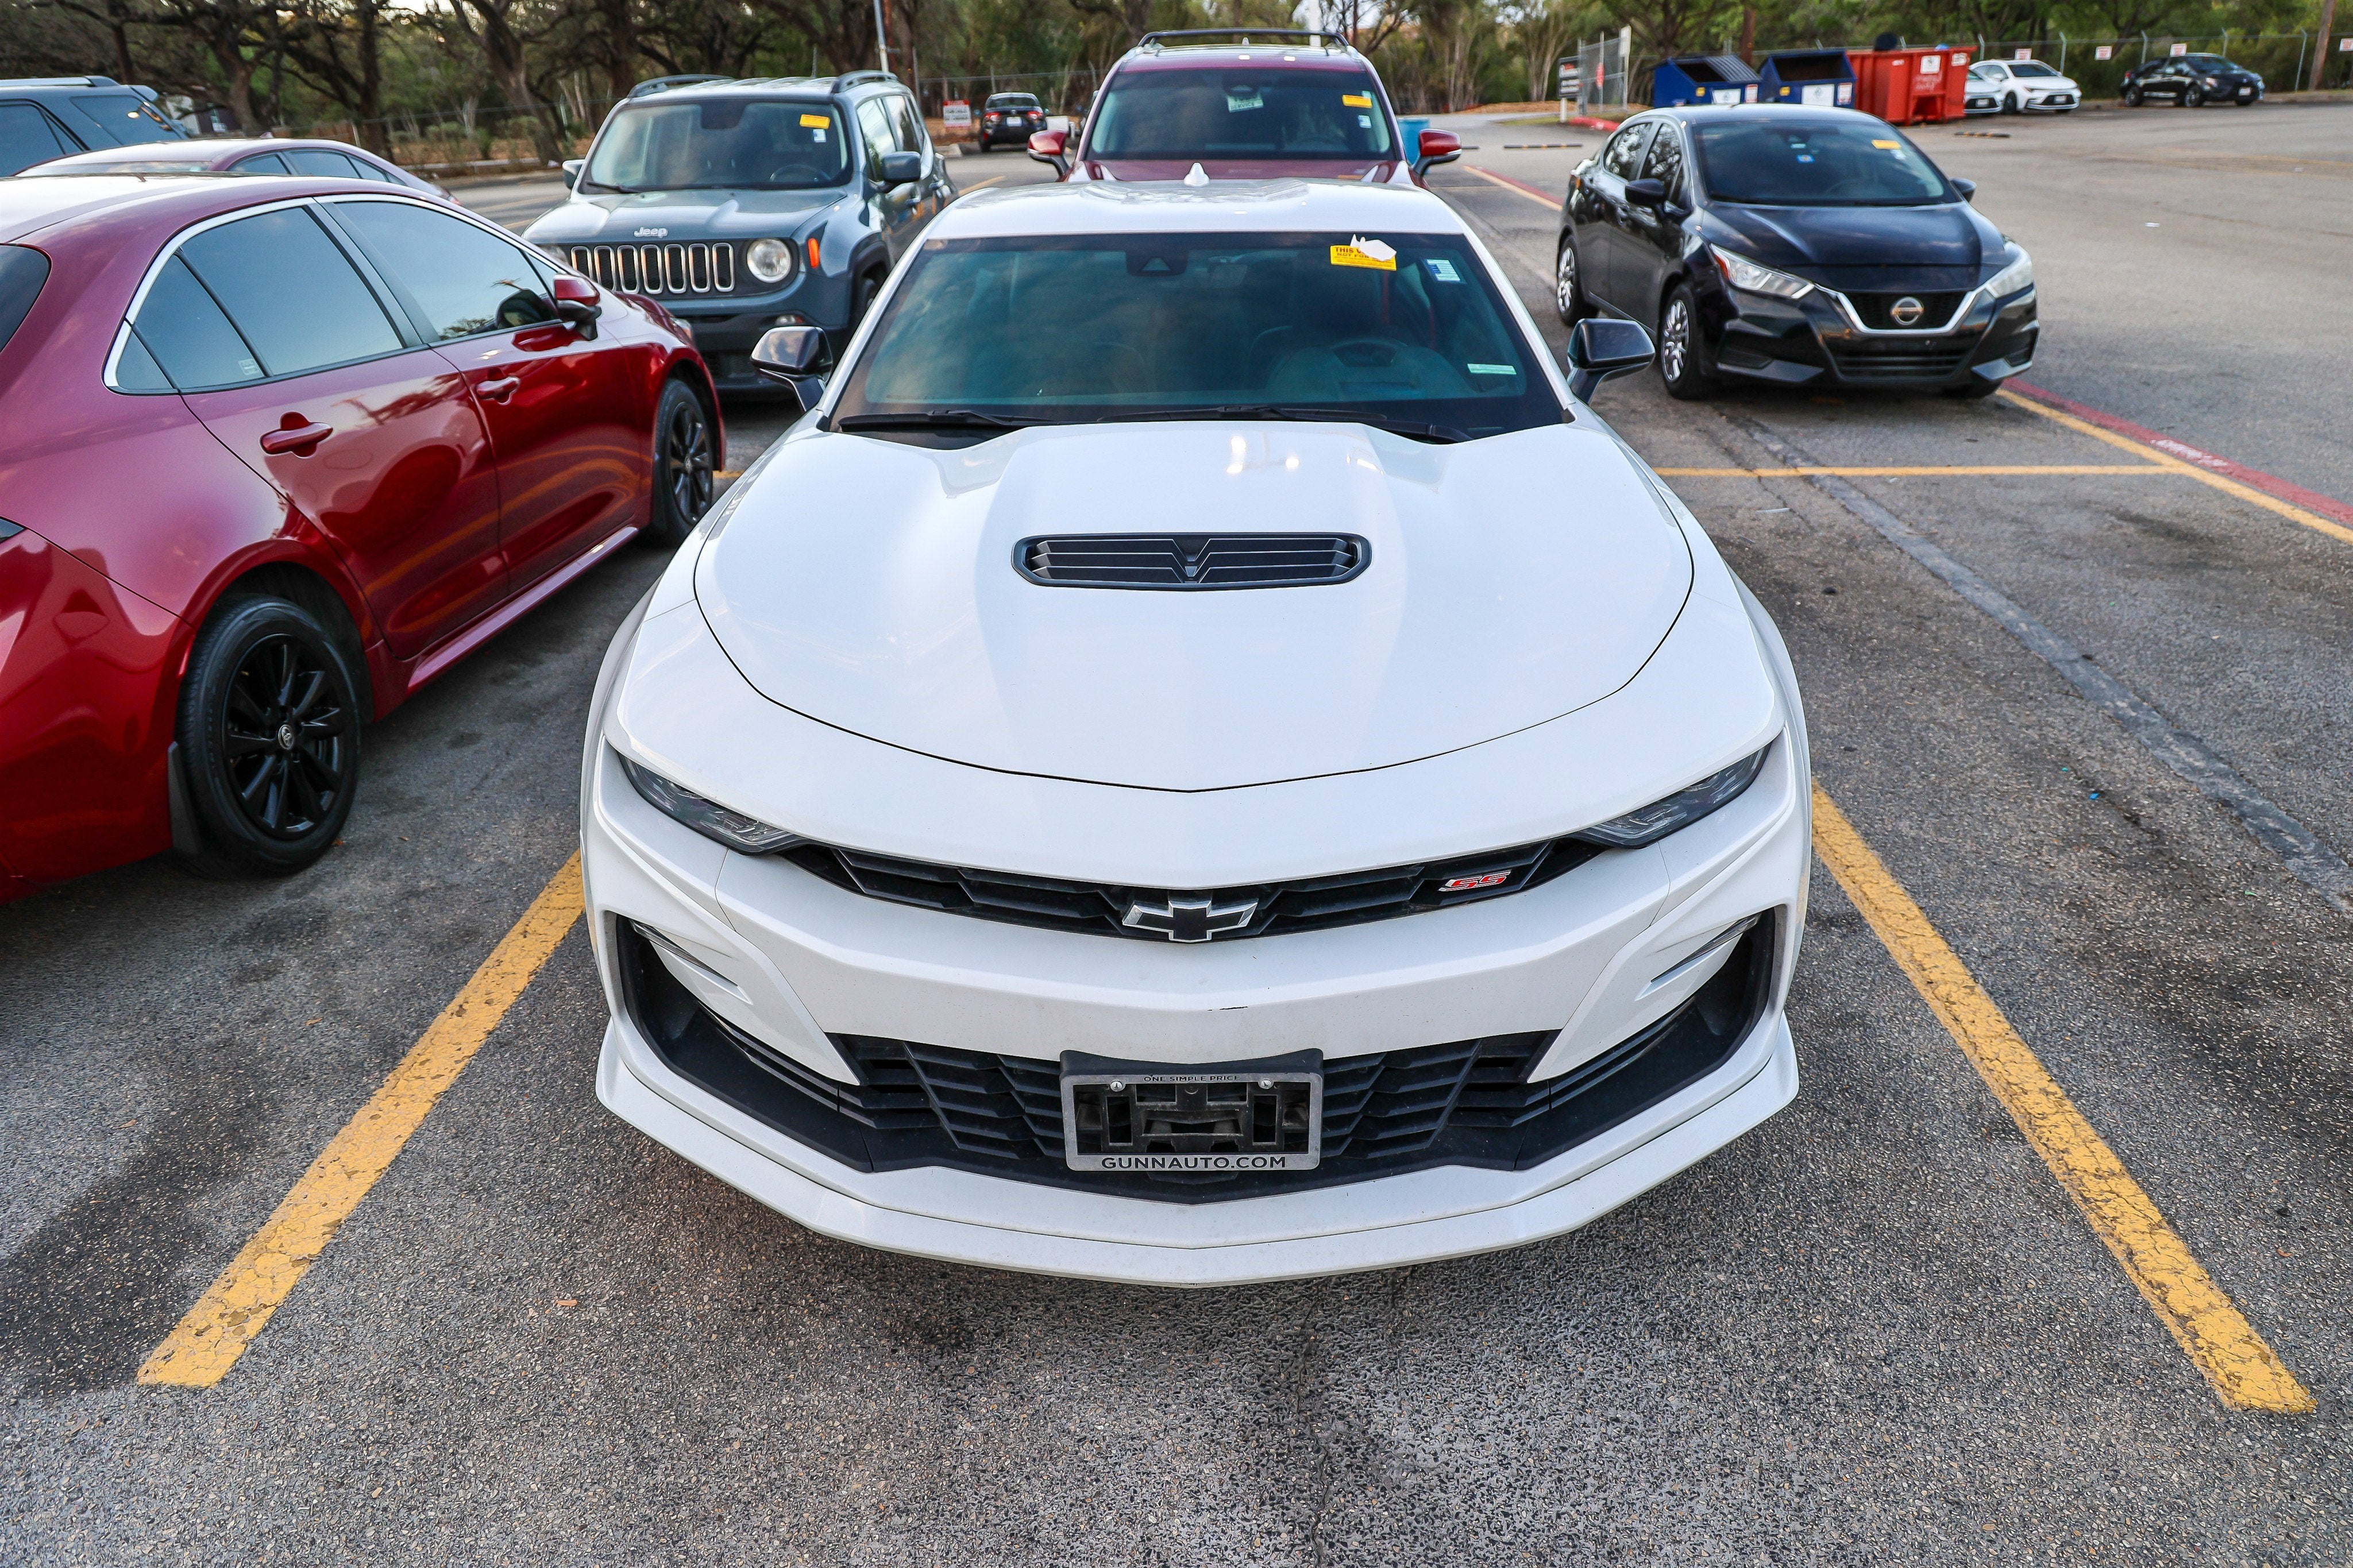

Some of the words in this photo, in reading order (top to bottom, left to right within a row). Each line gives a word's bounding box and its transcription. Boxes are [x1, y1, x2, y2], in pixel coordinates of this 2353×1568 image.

[634, 226, 668, 238] Jeep
[1438, 871, 1511, 891] SS
[1101, 1156, 1286, 1169] GUNNAUTO.COM
